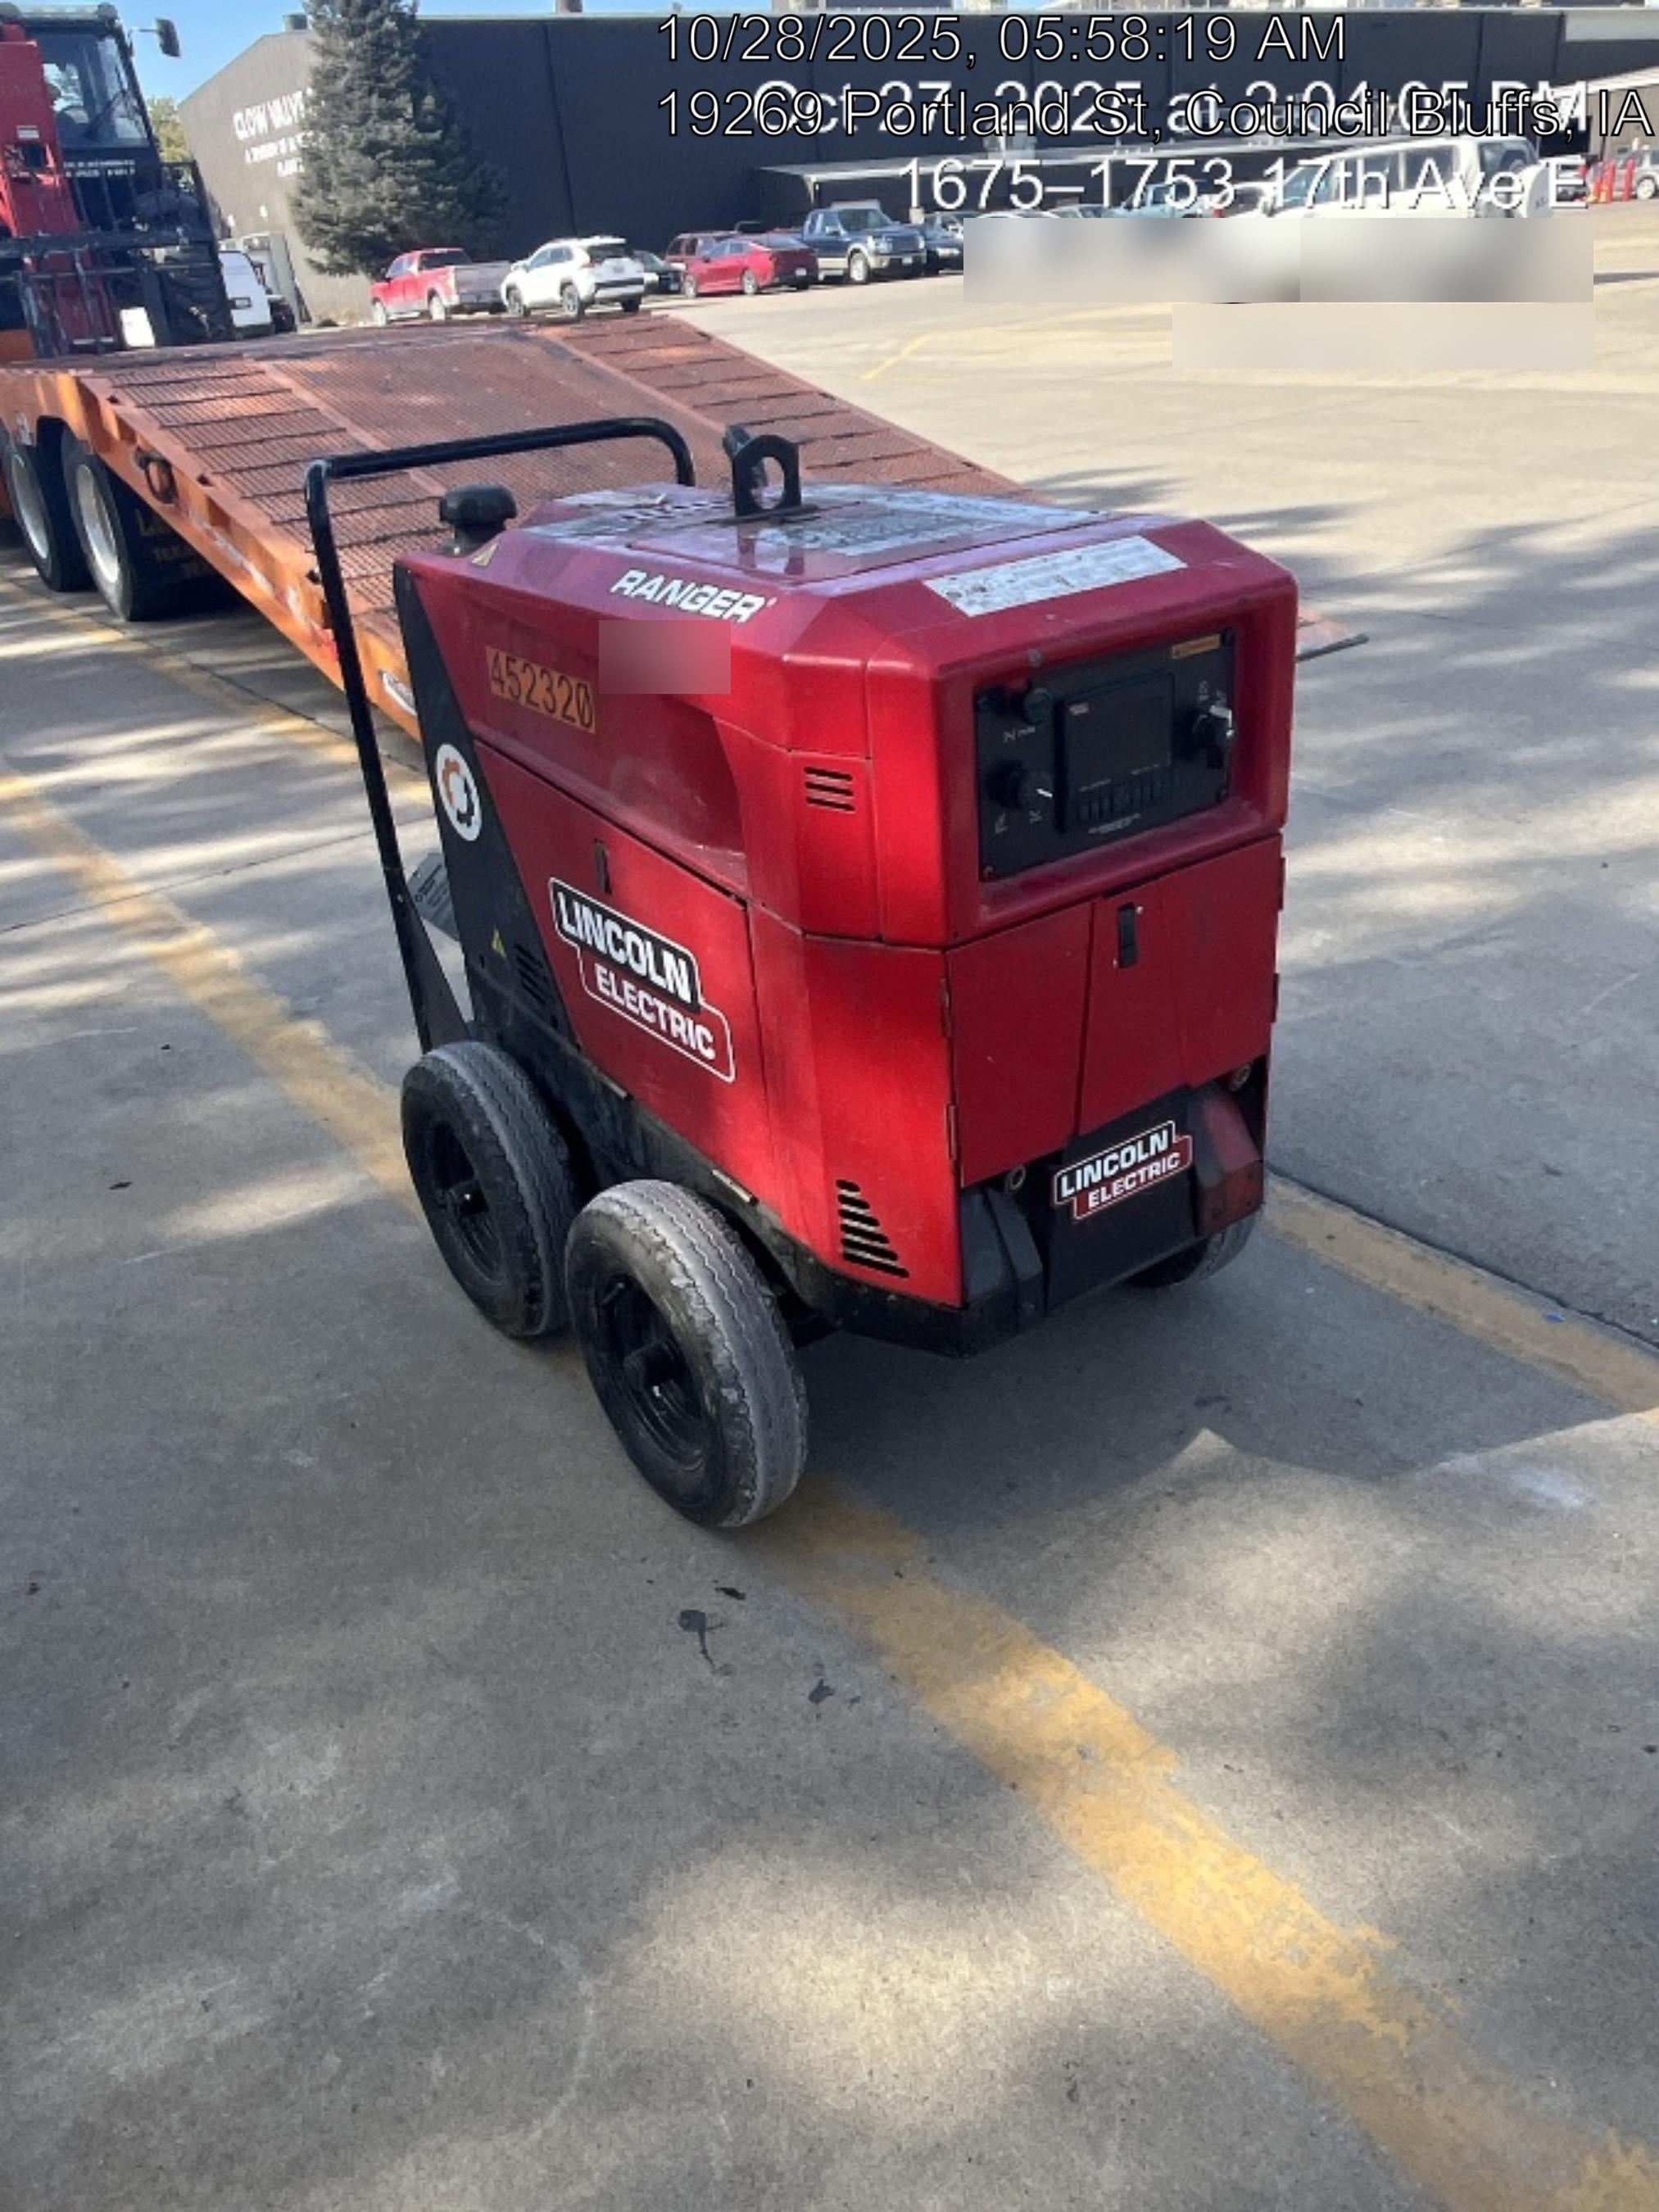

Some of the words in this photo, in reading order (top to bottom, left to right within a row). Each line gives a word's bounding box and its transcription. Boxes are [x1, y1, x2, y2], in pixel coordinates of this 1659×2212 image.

[610, 569, 765, 623] RANGER
[489, 650, 594, 728] 452320
[557, 891, 694, 1002] LINCOLN
[595, 963, 715, 1059] ELECTRIC
[1061, 1129, 1168, 1197] LINCOLN
[1088, 1152, 1181, 1209] ELECTRIC
